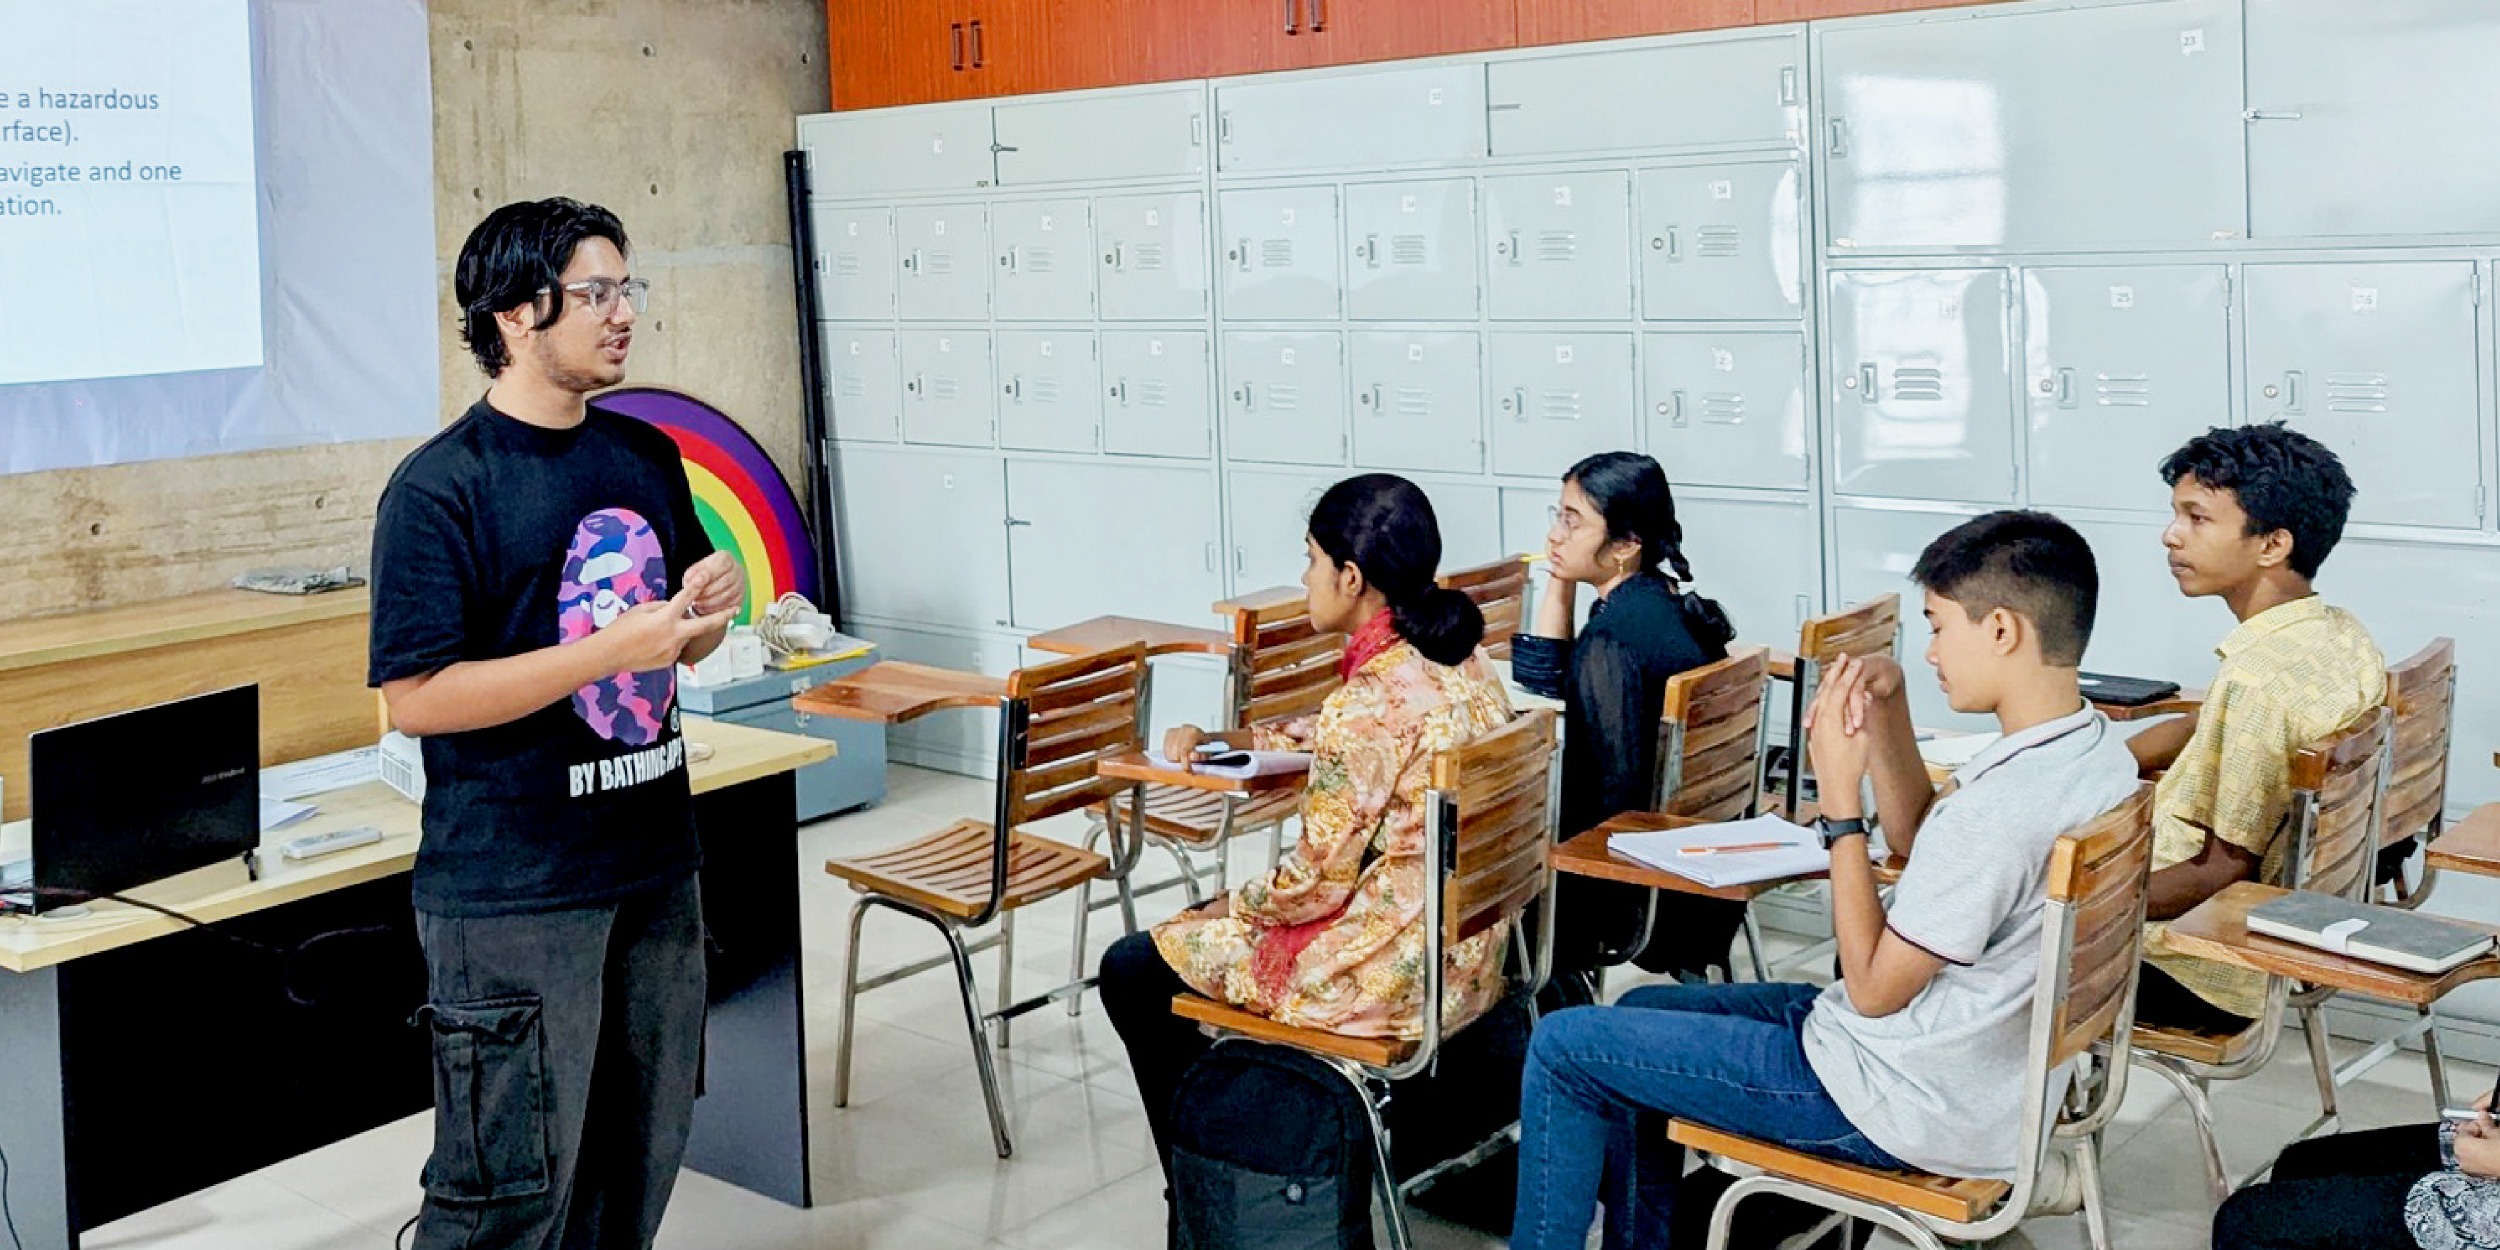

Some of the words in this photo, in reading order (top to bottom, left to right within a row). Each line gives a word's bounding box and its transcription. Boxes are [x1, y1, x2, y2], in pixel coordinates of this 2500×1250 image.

[18, 92, 31, 109] a
[39, 87, 160, 110] hazardous
[2, 119, 79, 147] rface).
[89, 160, 132, 182] and
[139, 164, 182, 181] one
[569, 762, 596, 798] BY
